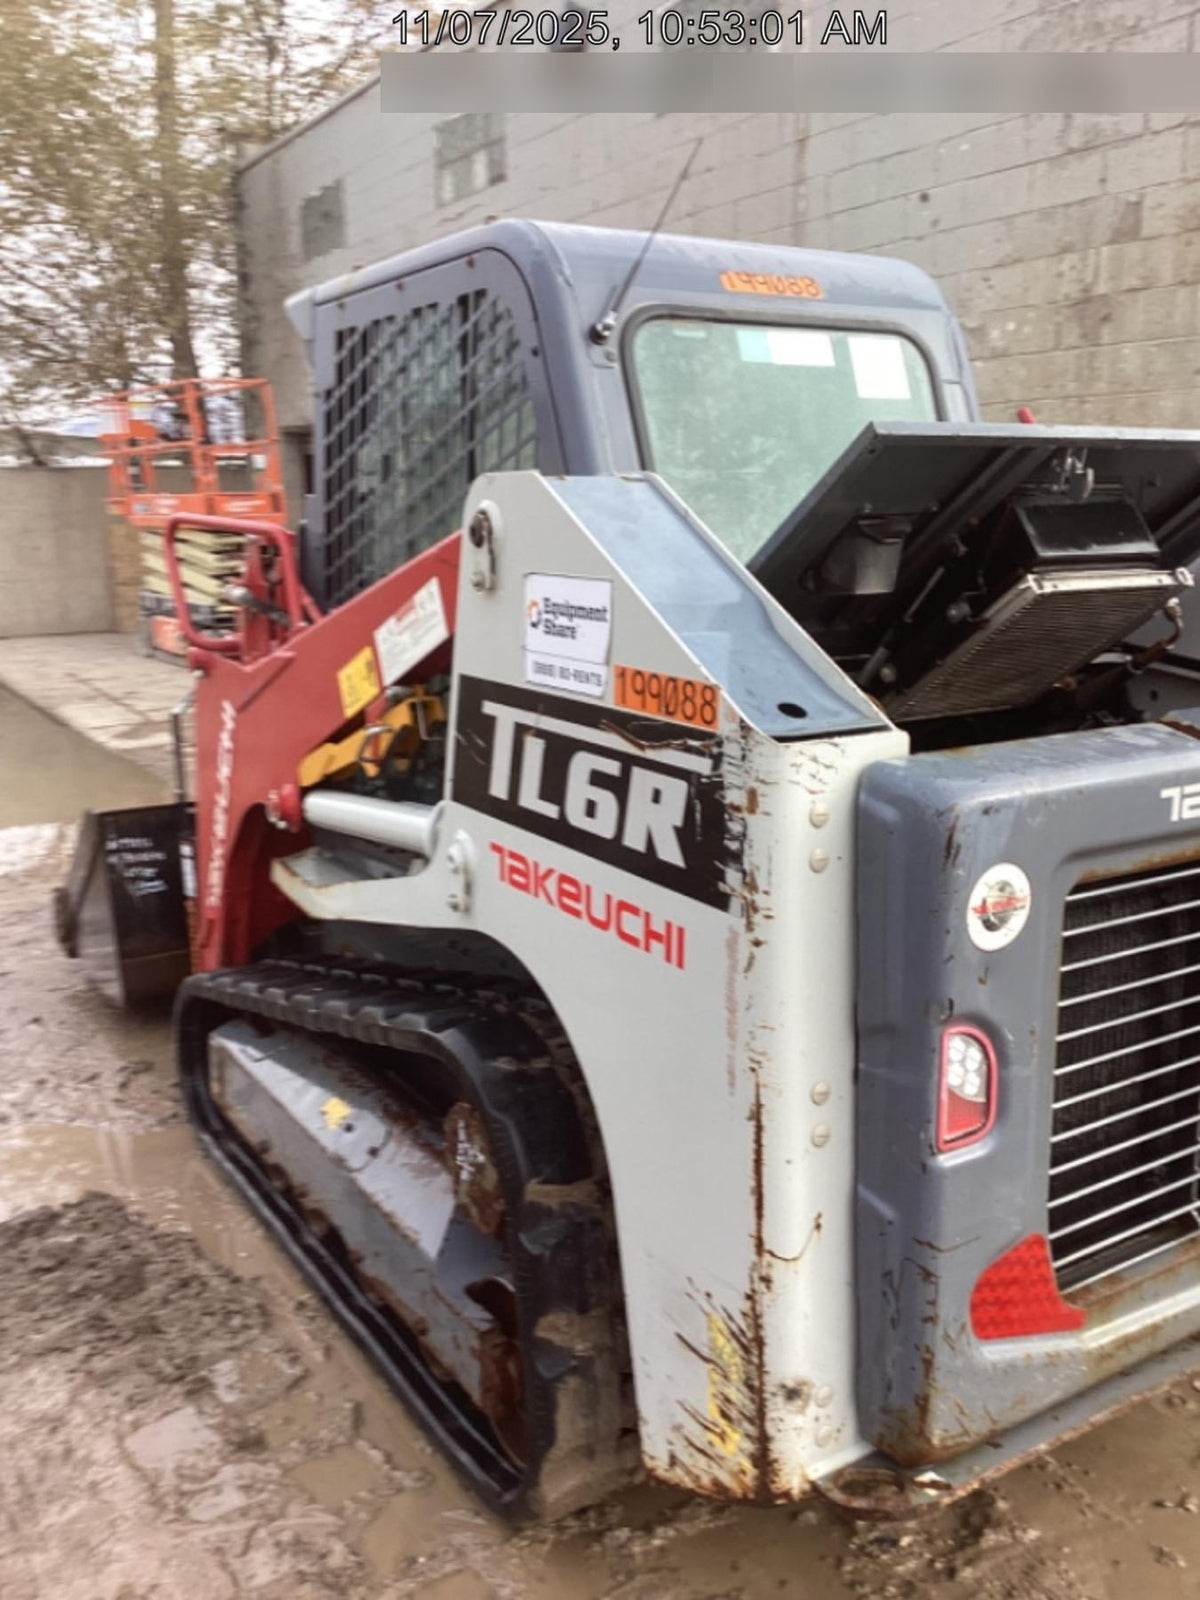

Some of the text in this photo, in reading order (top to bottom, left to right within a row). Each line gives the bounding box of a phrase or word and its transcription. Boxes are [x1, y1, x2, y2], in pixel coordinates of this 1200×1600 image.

[542, 597, 608, 623] Equipment
[542, 618, 577, 640] Share
[616, 666, 716, 725] 199088
[481, 700, 713, 869] TL6R
